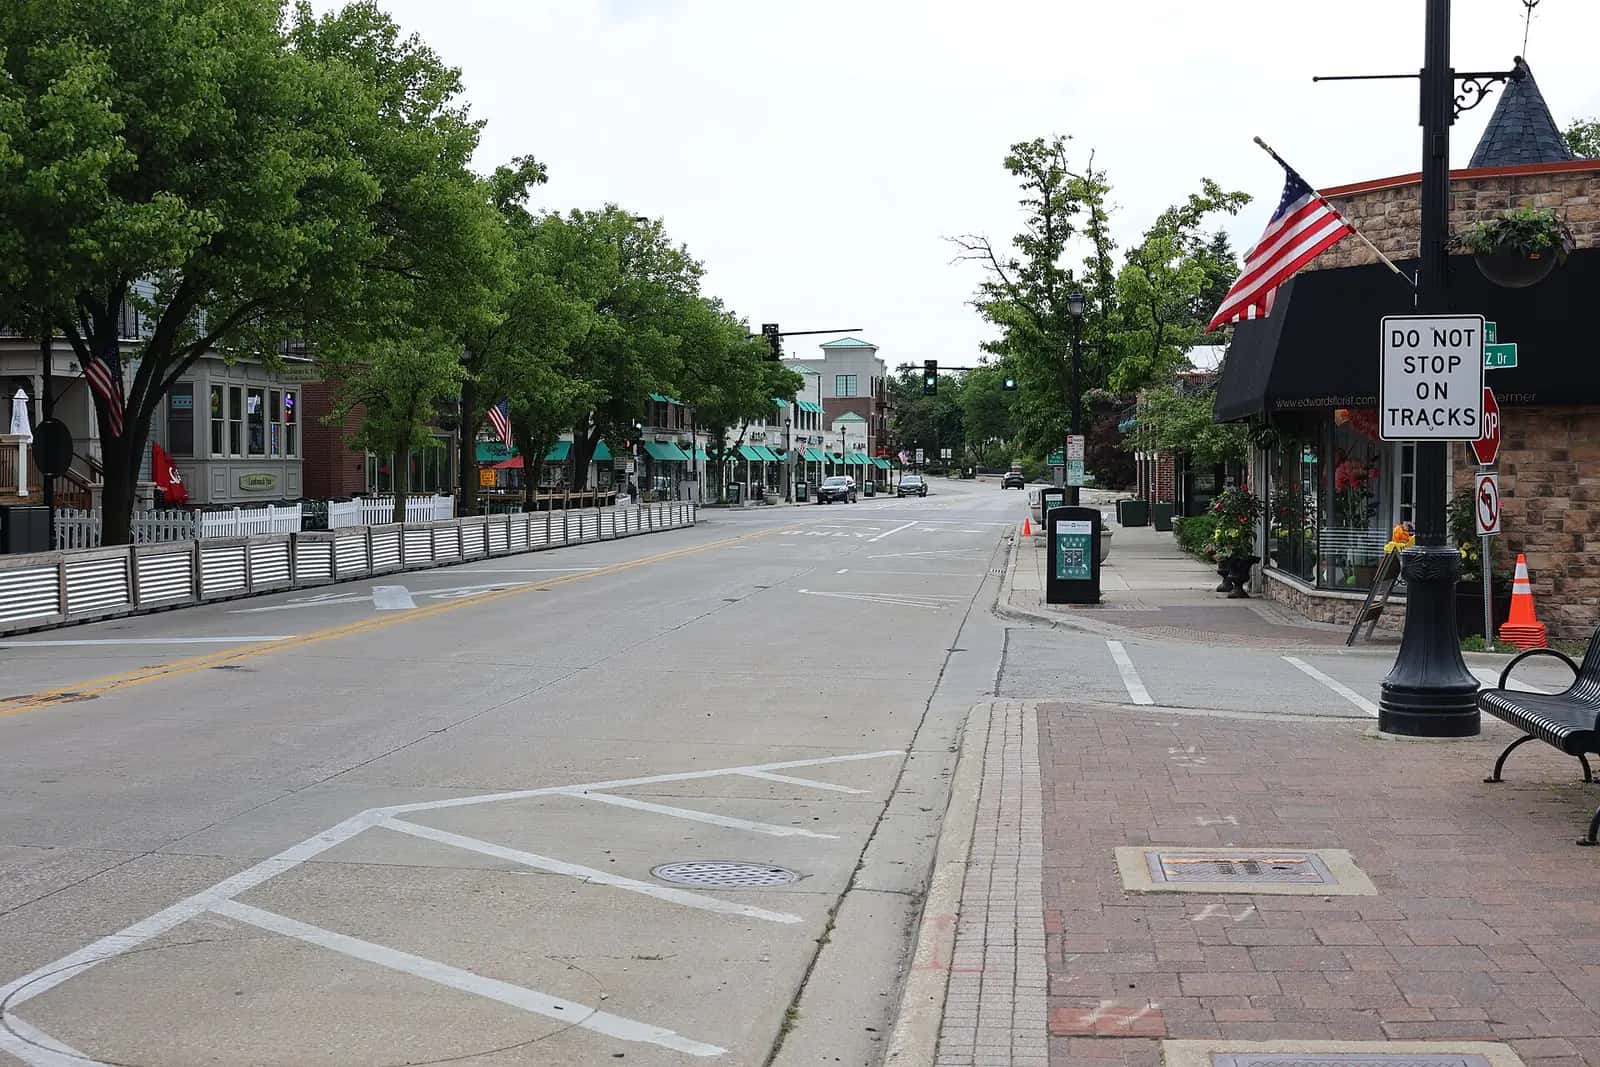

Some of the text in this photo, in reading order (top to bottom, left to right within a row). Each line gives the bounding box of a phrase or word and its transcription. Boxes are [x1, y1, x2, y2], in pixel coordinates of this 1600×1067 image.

[1391, 329, 1476, 348] DO NOT
[1403, 355, 1461, 374] STOP
[1497, 353, 1507, 365] Dr
[1416, 382, 1448, 400] ON
[1387, 408, 1476, 426] TRACKS
[1484, 412, 1498, 440] OP
